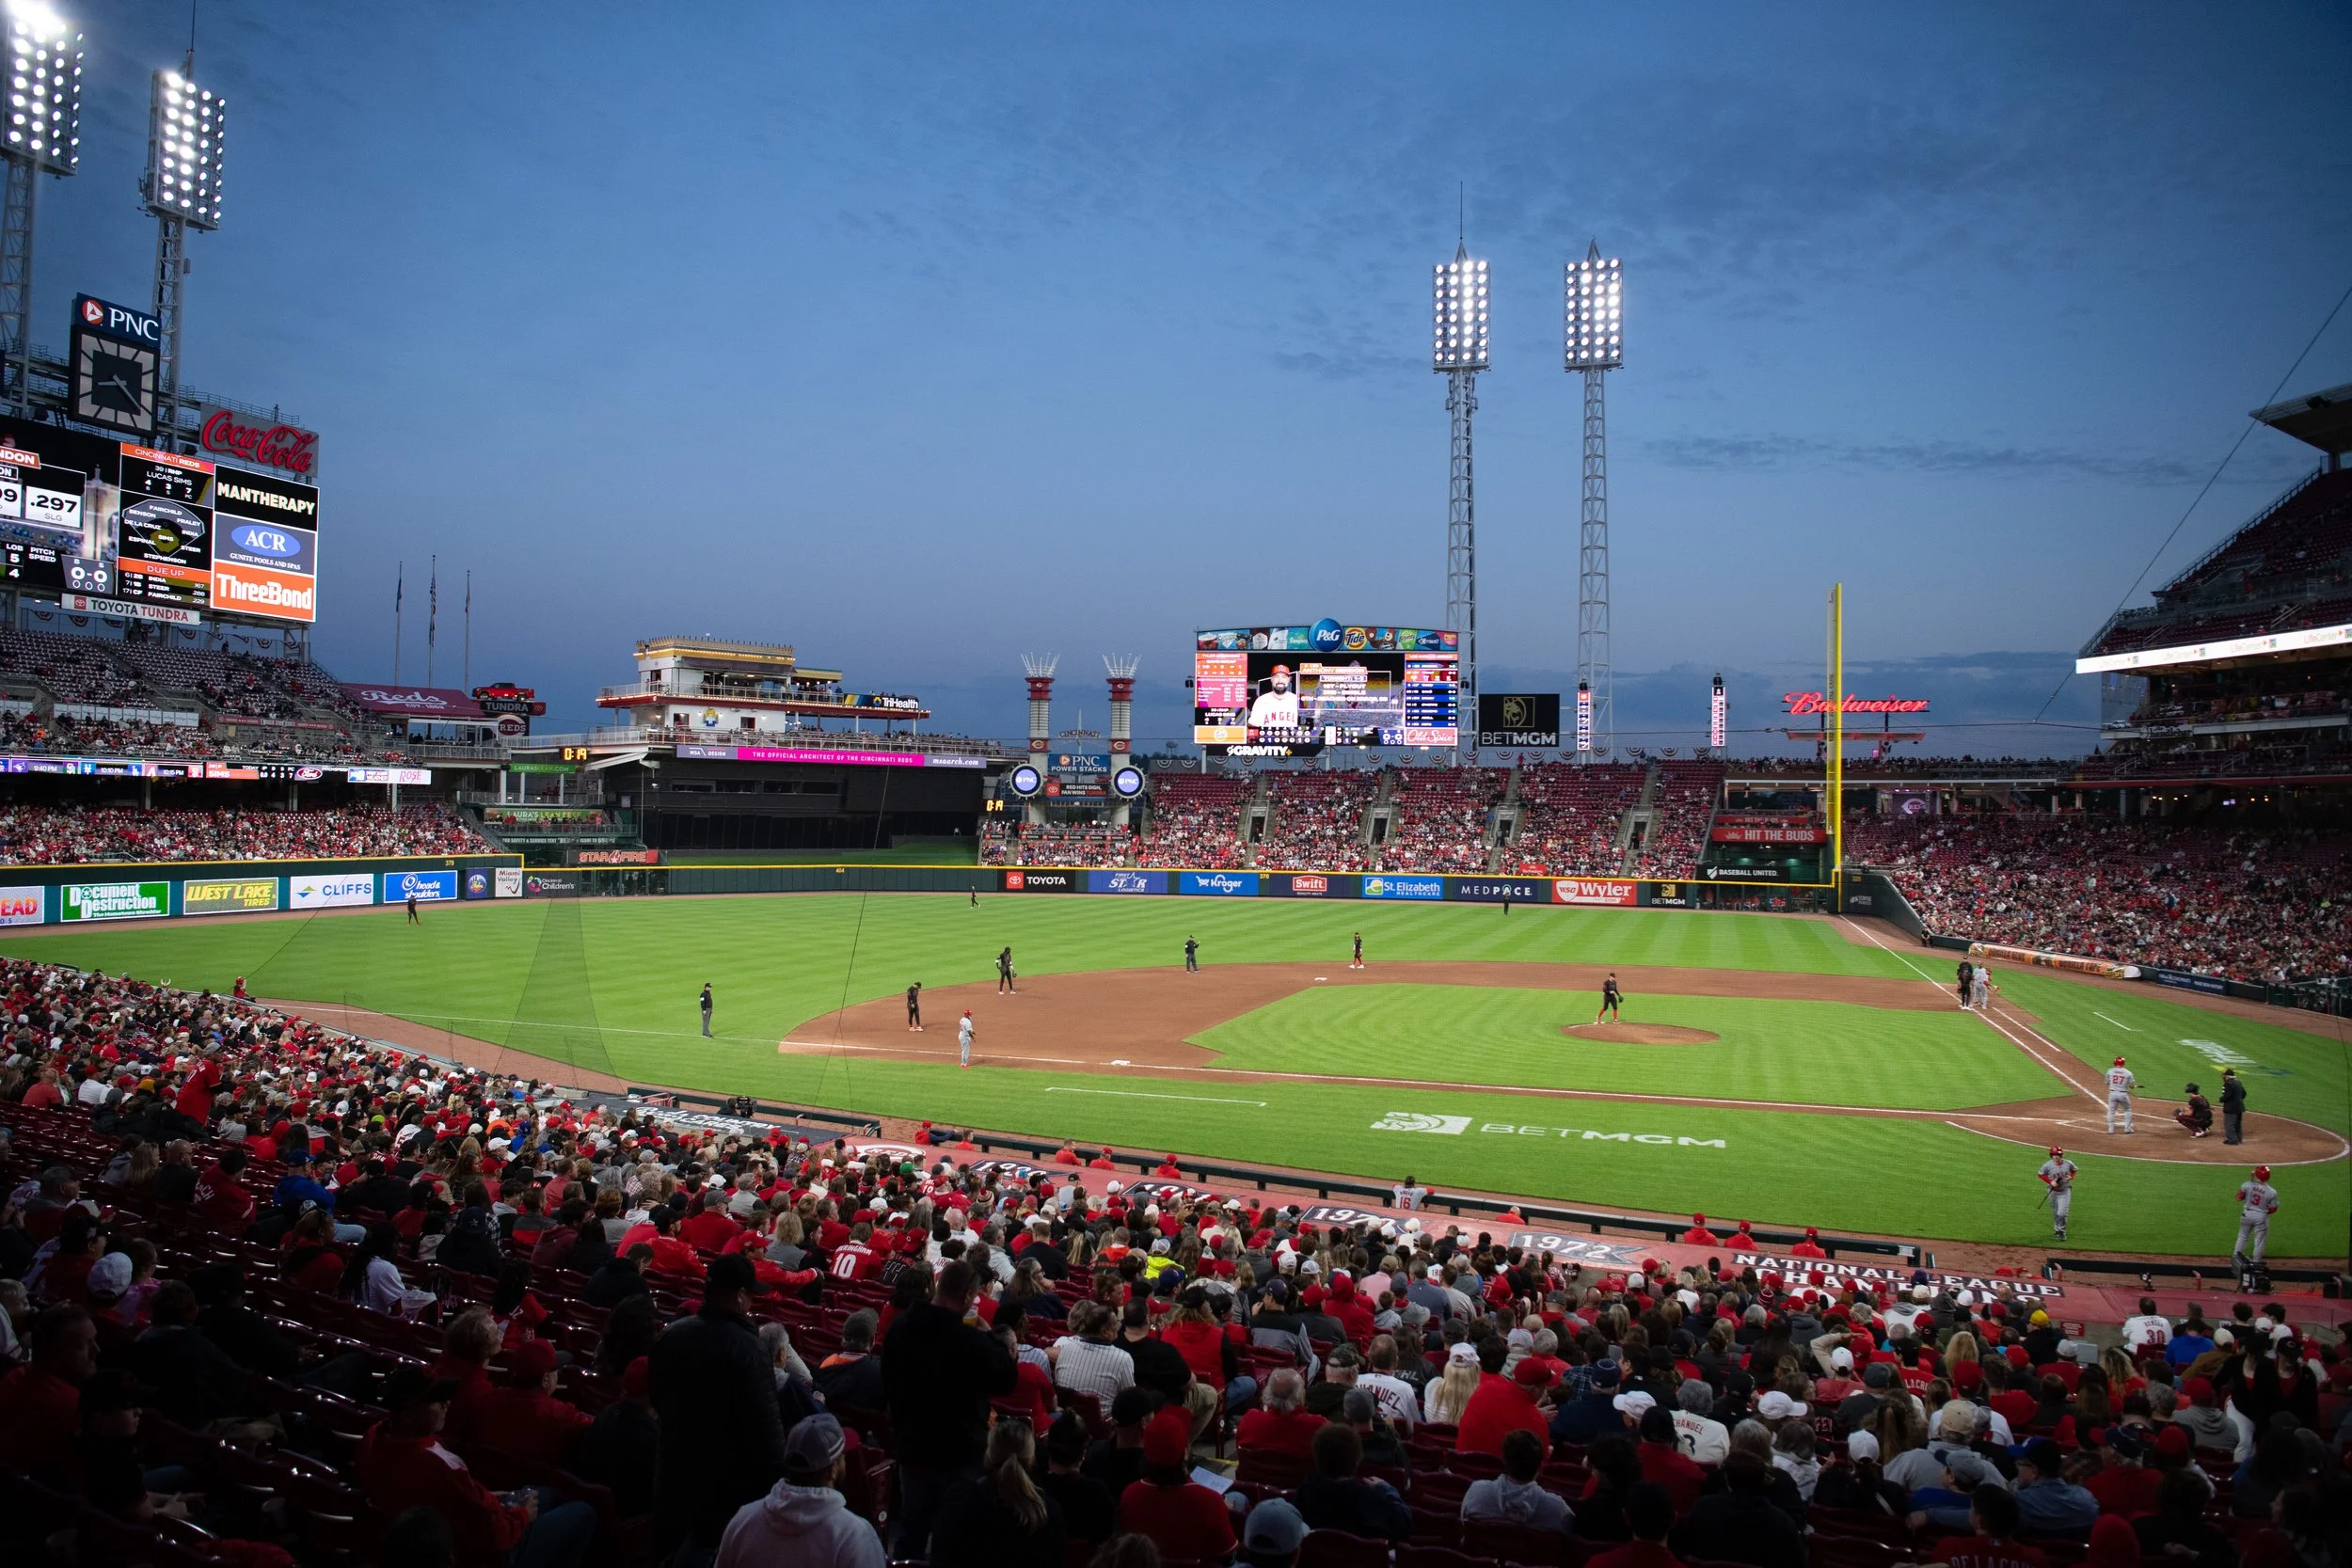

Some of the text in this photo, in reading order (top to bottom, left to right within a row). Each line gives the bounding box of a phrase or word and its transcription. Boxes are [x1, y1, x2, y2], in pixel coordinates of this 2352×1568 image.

[109, 307, 159, 341] PNC
[201, 410, 318, 472] Coca-Cola
[135, 449, 200, 468] CINCINNATI REDS
[147, 471, 193, 486] LUCAS SIMS
[31, 495, 77, 513] .297
[216, 482, 315, 515] MANTHERAPY
[129, 509, 157, 518] BENSON
[149, 505, 183, 515] FAIRCHILD
[245, 530, 286, 552] ACR
[30, 546, 56, 556] PITCH
[28, 554, 56, 562] SPEED
[144, 553, 187, 564] STEPHENSON
[230, 552, 301, 570] GUNITE POOLS AND SPAS
[8, 569, 20, 578] 4
[147, 565, 168, 574] DUE
[148, 583, 170, 592] STEER
[216, 573, 312, 610] ThreeBond
[148, 592, 183, 601] FAIRCHILD
[91, 599, 188, 622] TOYOTA TUNDRA
[1316, 629, 1341, 641] P&G
[1345, 631, 1365, 646] Tide
[485, 702, 529, 712] TUNDRA
[882, 697, 919, 709] TriHealth
[1784, 691, 1928, 715] Budweiser
[500, 723, 527, 732] REDS
[1059, 729, 1101, 738] CINCINNATI
[1407, 730, 1454, 743] Old Spice
[1482, 732, 1556, 745] BETMGM
[1072, 755, 1100, 766] PNC
[299, 768, 319, 779] Ford
[1745, 830, 1815, 841] HIT THE BUDS
[580, 850, 646, 863] STAR FIRE
[1719, 868, 1752, 877] BASEBALL
[497, 876, 517, 884] Valley
[1026, 876, 1067, 885] TOYOTA
[1211, 874, 1242, 893] Kroger
[1295, 879, 1324, 889] Swift
[186, 882, 274, 902] WEST LAKE
[323, 883, 372, 896] CLIFFS
[1384, 881, 1440, 892] St. Elizabeth
[1580, 881, 1632, 900] Wyler
[404, 890, 440, 898] shoulders
[81, 896, 157, 919] Destruction
[244, 897, 270, 908] TIRES
[2112, 1075, 2124, 1085] 27
[1480, 1122, 1726, 1148] BETMGM
[1400, 1196, 1411, 1209] 16
[2251, 1194, 2261, 1205] 3
[1521, 1234, 1613, 1259] 1972
[832, 1253, 857, 1278] 10
[1736, 1254, 2061, 1297] NATIONAL LEAGUE
[2146, 1329, 2167, 1344] 30
